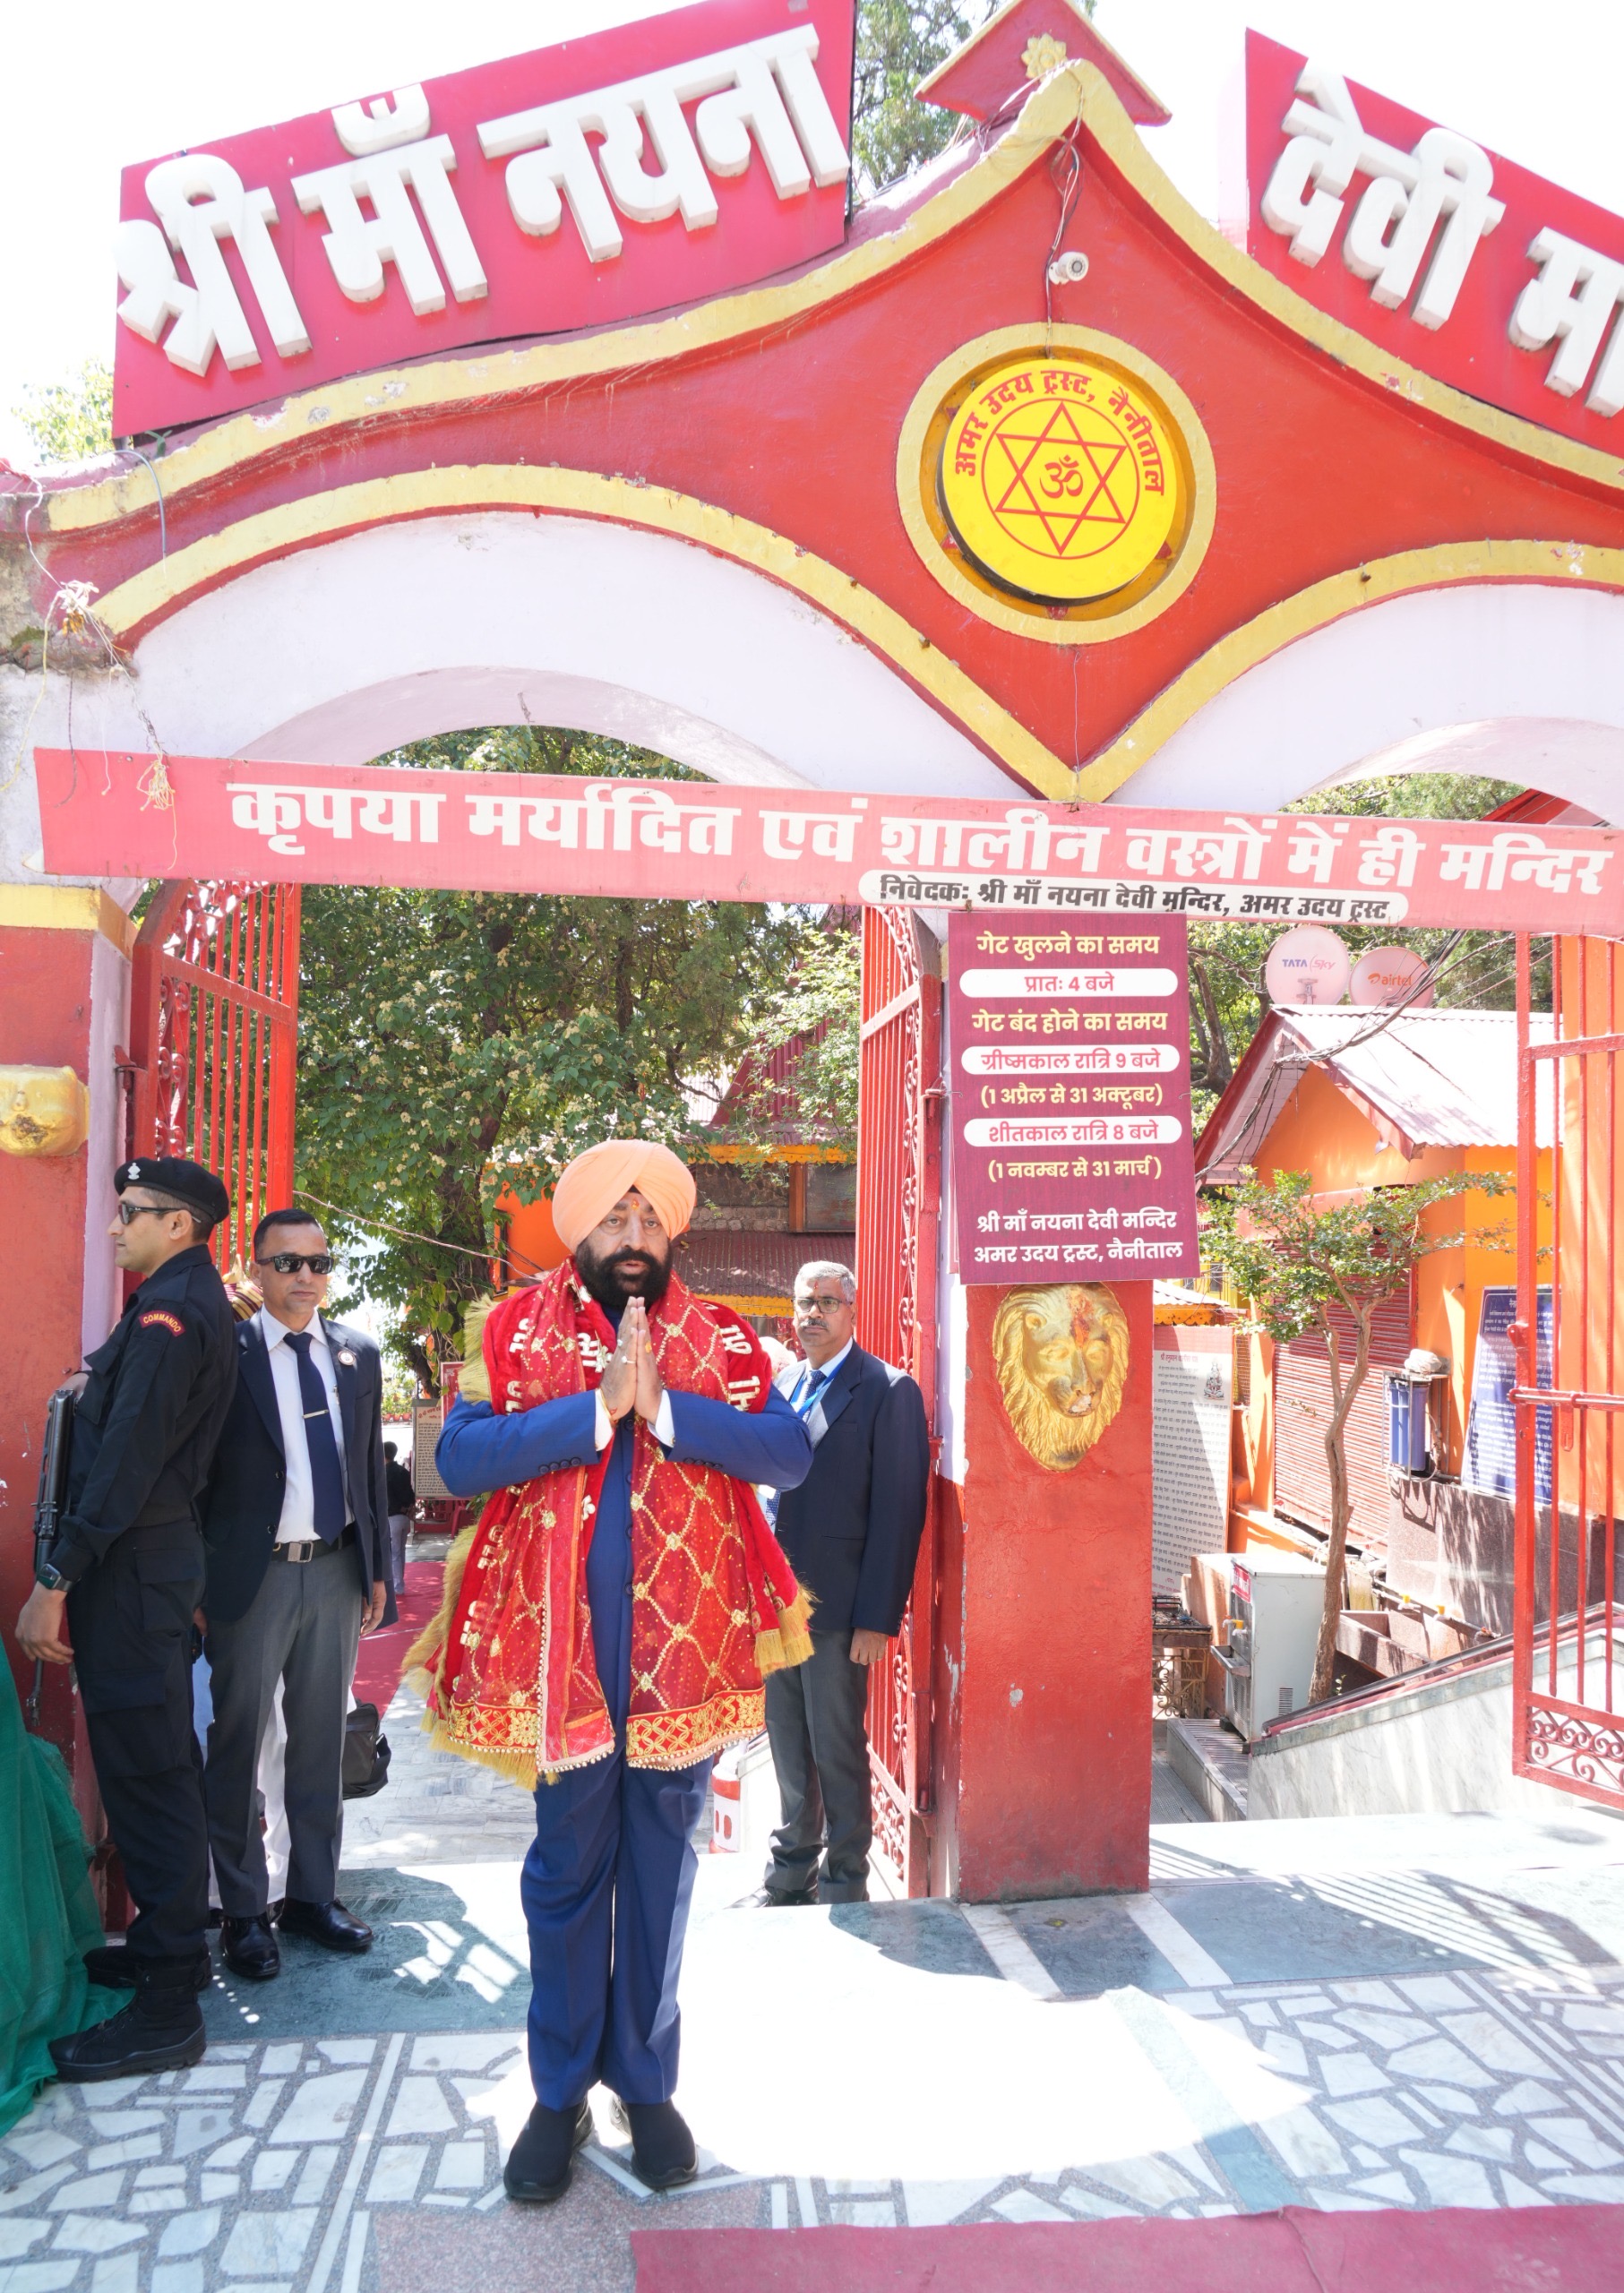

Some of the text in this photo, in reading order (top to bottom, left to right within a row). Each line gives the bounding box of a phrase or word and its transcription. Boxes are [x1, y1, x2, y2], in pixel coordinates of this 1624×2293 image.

[112, 23, 850, 378] श्री माँ नयना
[1260, 56, 1507, 331] देवी
[955, 370, 1164, 496] अमर उदय ट्रस्ट, नैनीताल
[226, 783, 1614, 895] कृपया मर्यादित एवं शालीन वस्त्रों में ही मन्दिर
[977, 878, 1008, 904] श्री
[1013, 879, 1043, 905] माँ
[1047, 885, 1110, 906] नयना
[1116, 882, 1156, 909] देवी
[1162, 886, 1230, 916] मन्दिर,
[1240, 894, 1293, 915] अमर
[1297, 897, 1345, 917] उदय
[1349, 899, 1390, 923] ट्रस्ट
[976, 931, 1160, 961] गेट खुलने का समय
[1282, 958, 1308, 968] TATA
[1069, 976, 1079, 992] 4
[1085, 971, 1114, 992] बजे
[1381, 974, 1412, 986] airtel
[972, 1008, 1168, 1034] गेट बंद होने का समय
[981, 1048, 1161, 1070] ग्रीष्मकाल रात्रि 9 बजे
[981, 1082, 1163, 1109] (1 अप्रैल से 31 अक्टूबर)
[989, 1120, 1158, 1142] शीतकाल रात्रि 8 बजे
[988, 1160, 1003, 1182] (1
[1007, 1162, 1069, 1177] नवम्बर
[1072, 1156, 1087, 1177] से
[1093, 1161, 1110, 1176] 31
[976, 1207, 1177, 1232] श्री माँ नयना देवी मन्दिर
[974, 1237, 1183, 1263] अमर उदय ट्रस्ट, नैनीताल
[143, 1313, 182, 1333] COMMANDO
